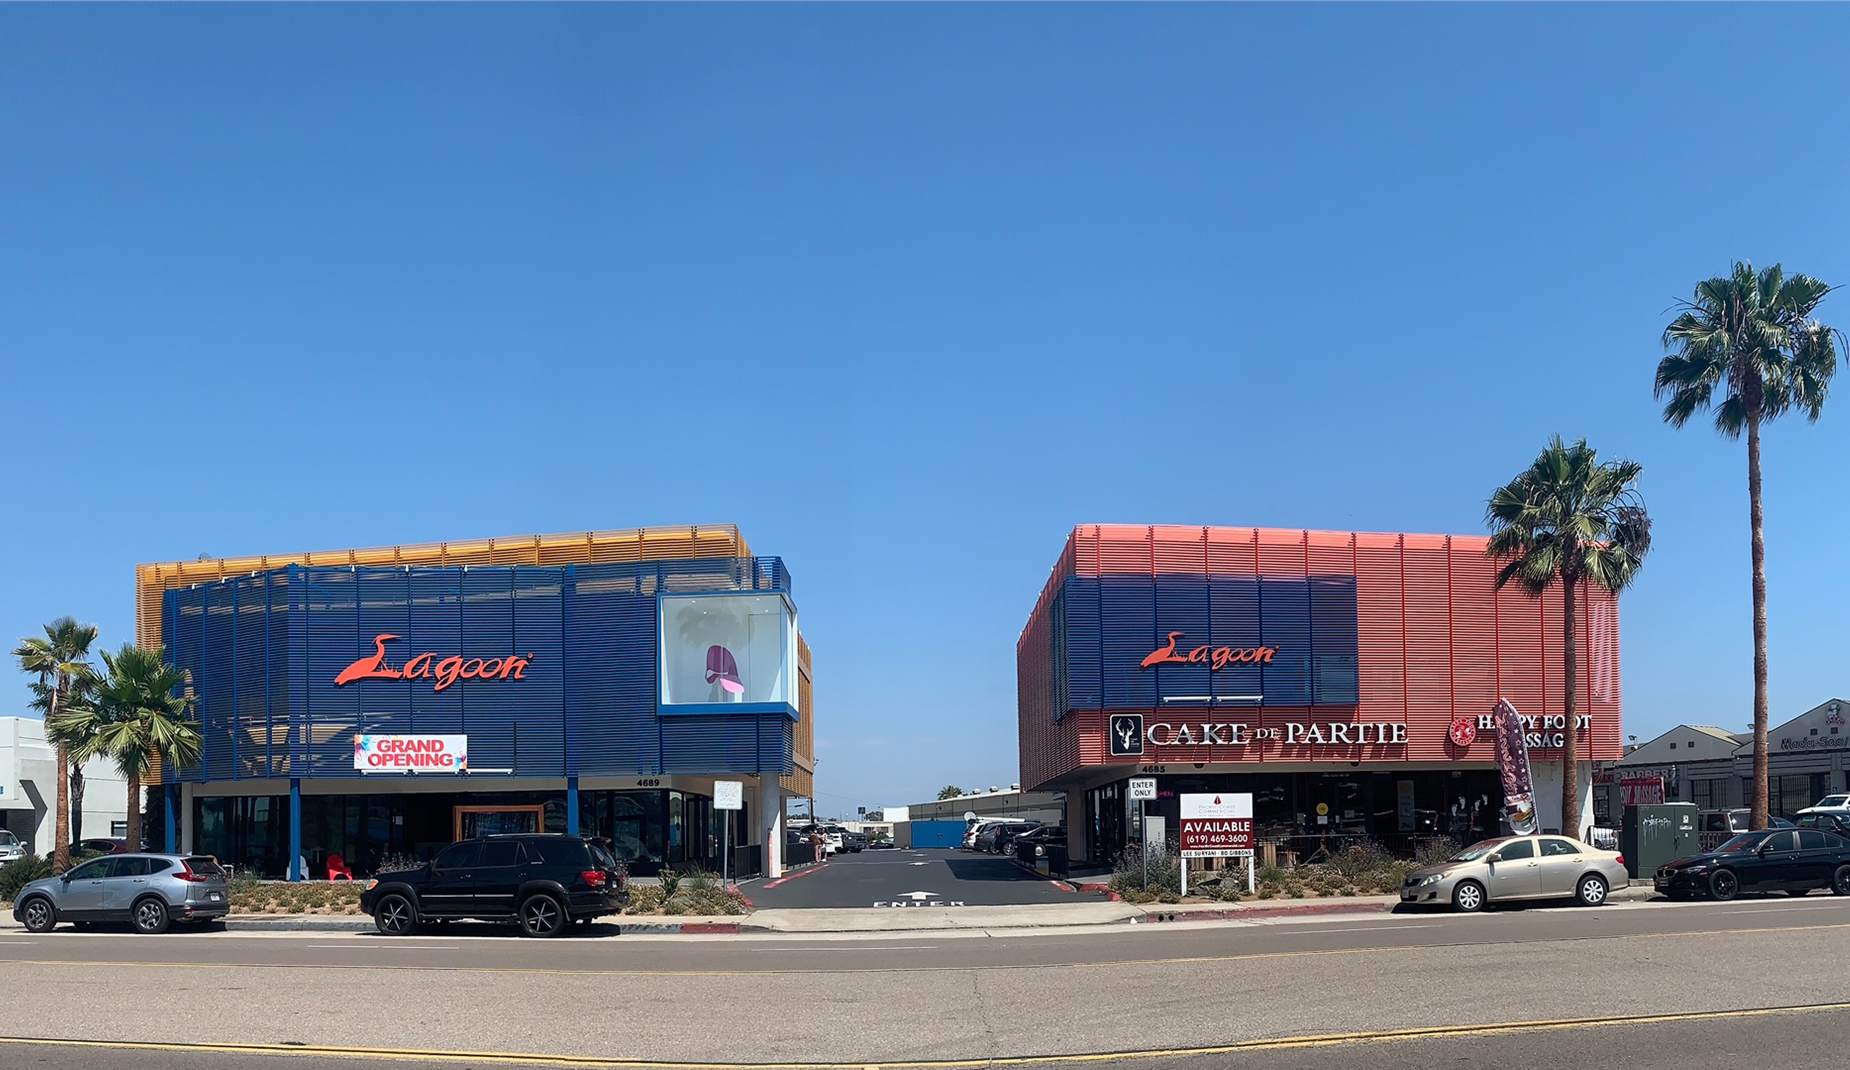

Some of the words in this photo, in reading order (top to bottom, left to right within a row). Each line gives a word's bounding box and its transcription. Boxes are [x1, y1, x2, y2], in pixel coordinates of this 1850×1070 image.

[1477, 715, 1536, 729] HPY
[1147, 723, 1249, 745] CAKE
[1255, 727, 1279, 739] DE
[1285, 722, 1408, 744] PARTIE
[1525, 733, 1565, 747] SSAG
[376, 739, 444, 753] GRAND
[367, 753, 453, 766] OPENING
[1621, 769, 1669, 780] BARBER
[637, 779, 660, 787] 4689
[1132, 781, 1154, 789] ENTER
[1134, 789, 1152, 797] ONLY
[1184, 822, 1250, 832] AVAILABLE
[1186, 835, 1208, 844] (619)
[1210, 834, 1248, 843] 469-3600
